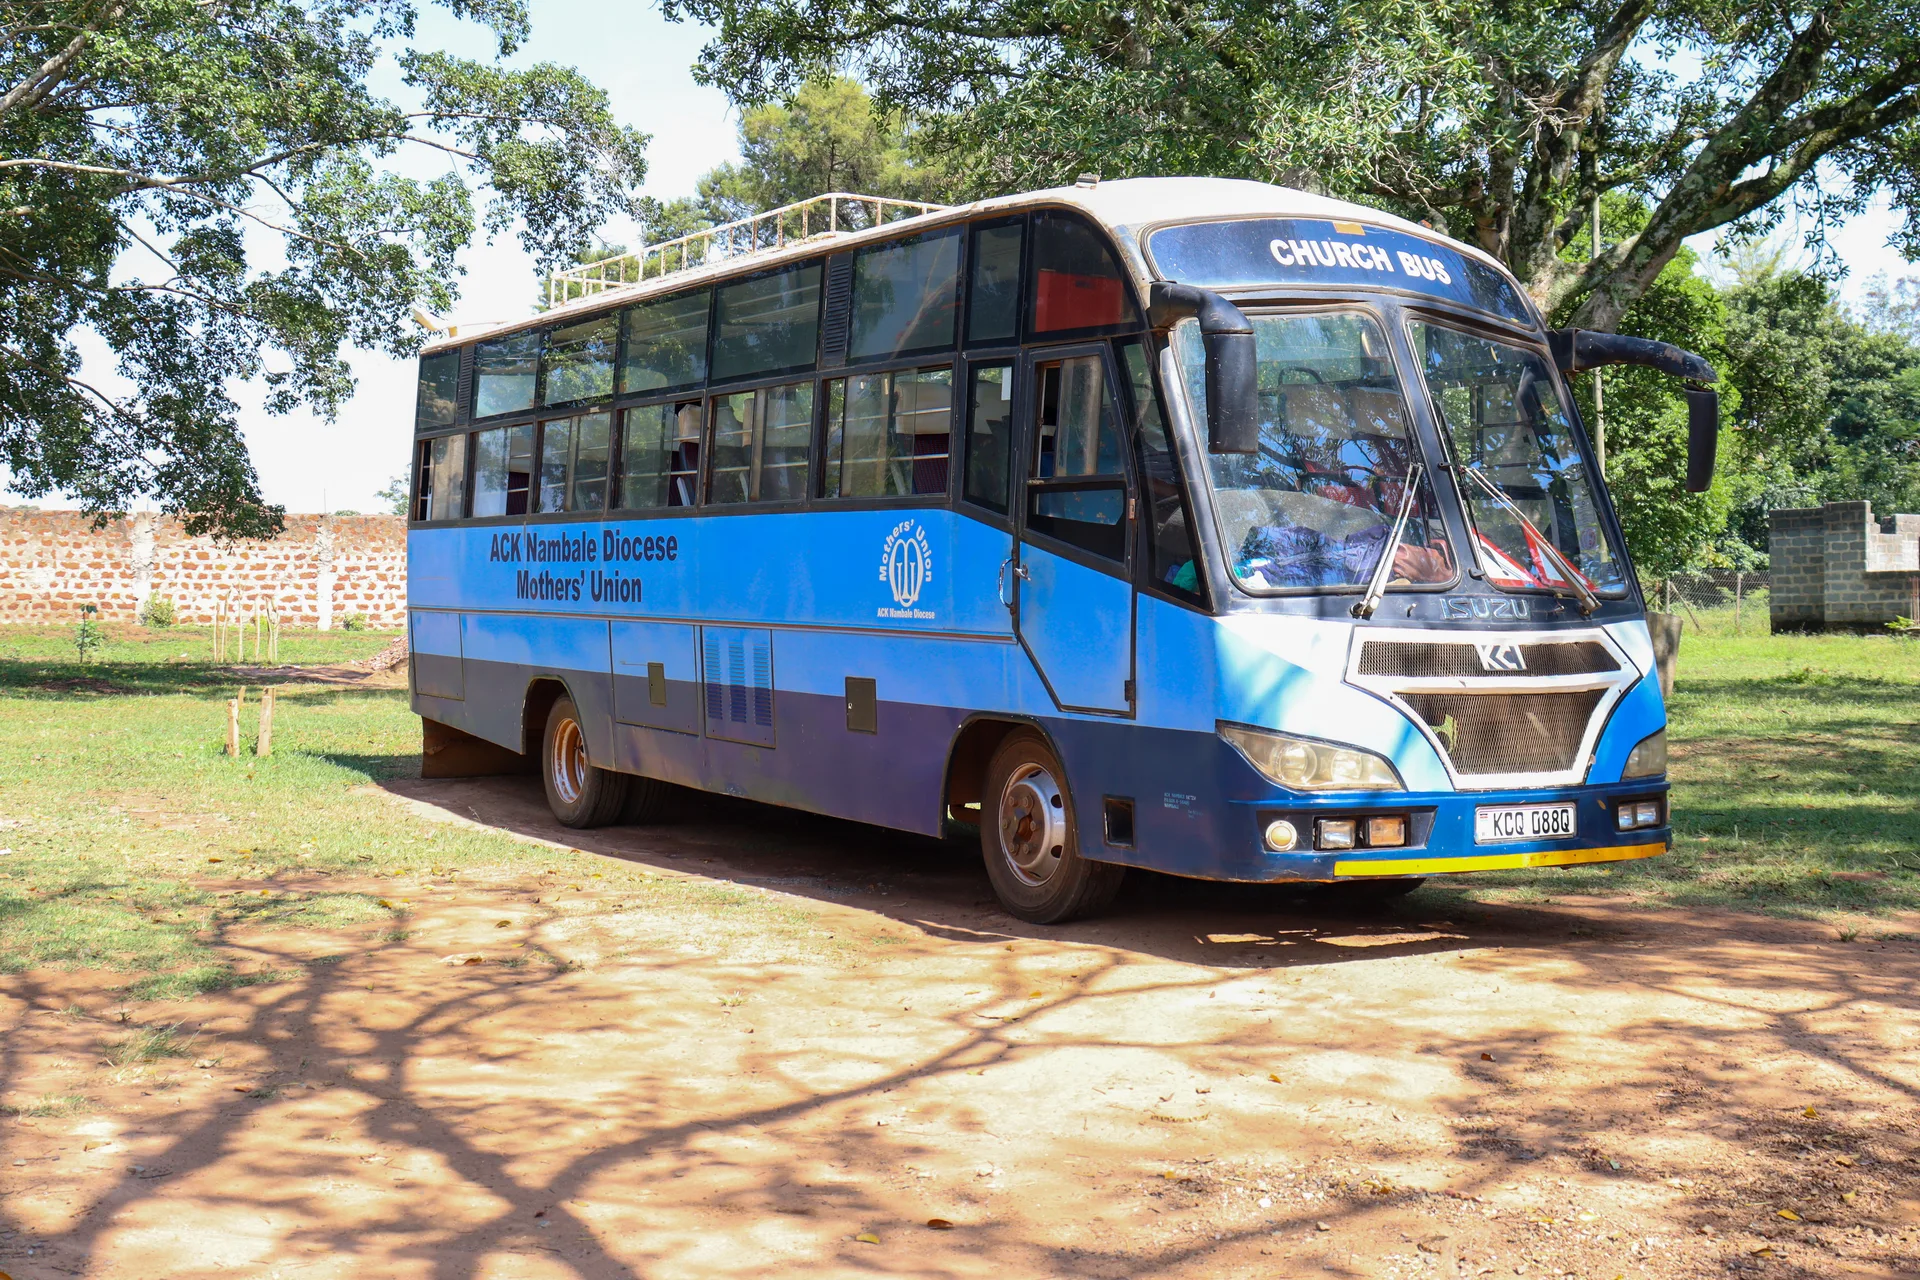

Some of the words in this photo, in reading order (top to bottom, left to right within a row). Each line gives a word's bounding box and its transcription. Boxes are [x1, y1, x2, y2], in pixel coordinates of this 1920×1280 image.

[1270, 239, 1395, 273] CHURCH
[1396, 250, 1452, 285] BUS
[490, 532, 522, 563] ACK
[526, 531, 597, 563] Nambale
[603, 529, 678, 562] Diocese
[916, 525, 932, 582] Union
[590, 569, 642, 603] Union
[877, 607, 889, 618] ACK
[889, 608, 913, 618] Nambale
[913, 608, 936, 619] Diocese
[1439, 598, 1531, 620] ISUZU
[1493, 811, 1525, 837] KCQ
